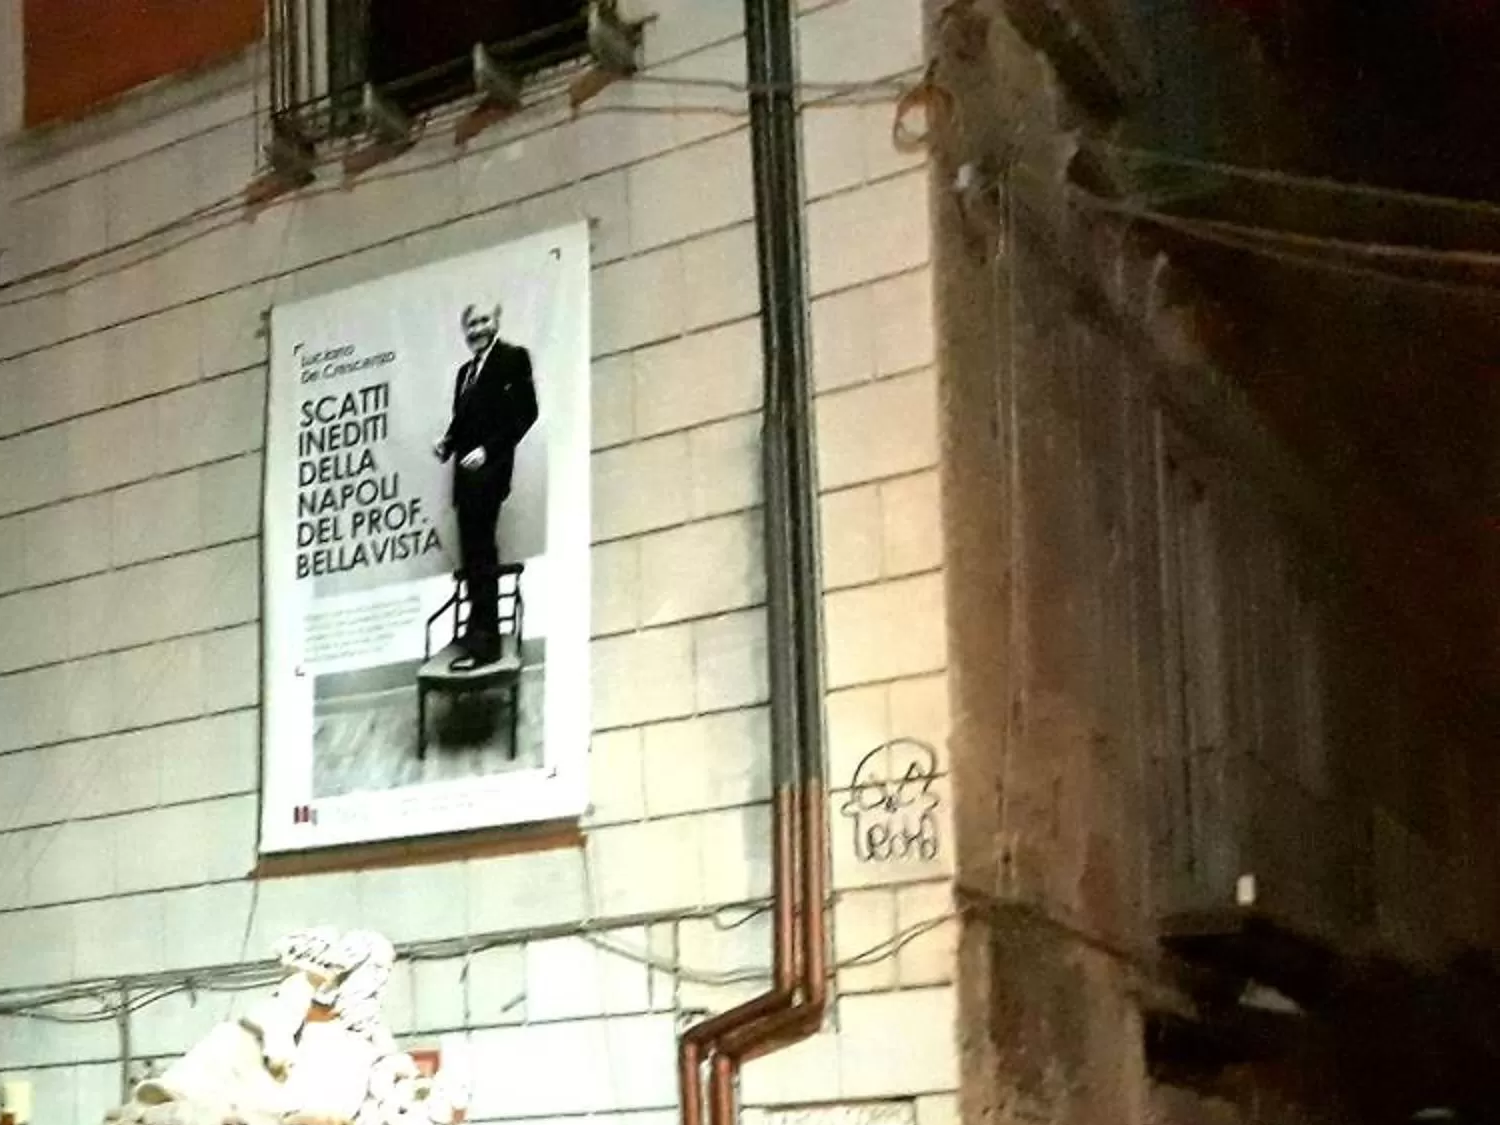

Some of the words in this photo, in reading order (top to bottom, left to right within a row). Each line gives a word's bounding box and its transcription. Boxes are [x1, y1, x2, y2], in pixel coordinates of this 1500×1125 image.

[299, 381, 390, 428] SCATTI
[298, 412, 389, 457] INEDITI
[298, 448, 377, 488] DELLA
[298, 472, 399, 518] NAPOLI
[297, 516, 343, 549] DEL
[350, 497, 430, 539] PROF.
[296, 527, 443, 580] BELLAVISTA
